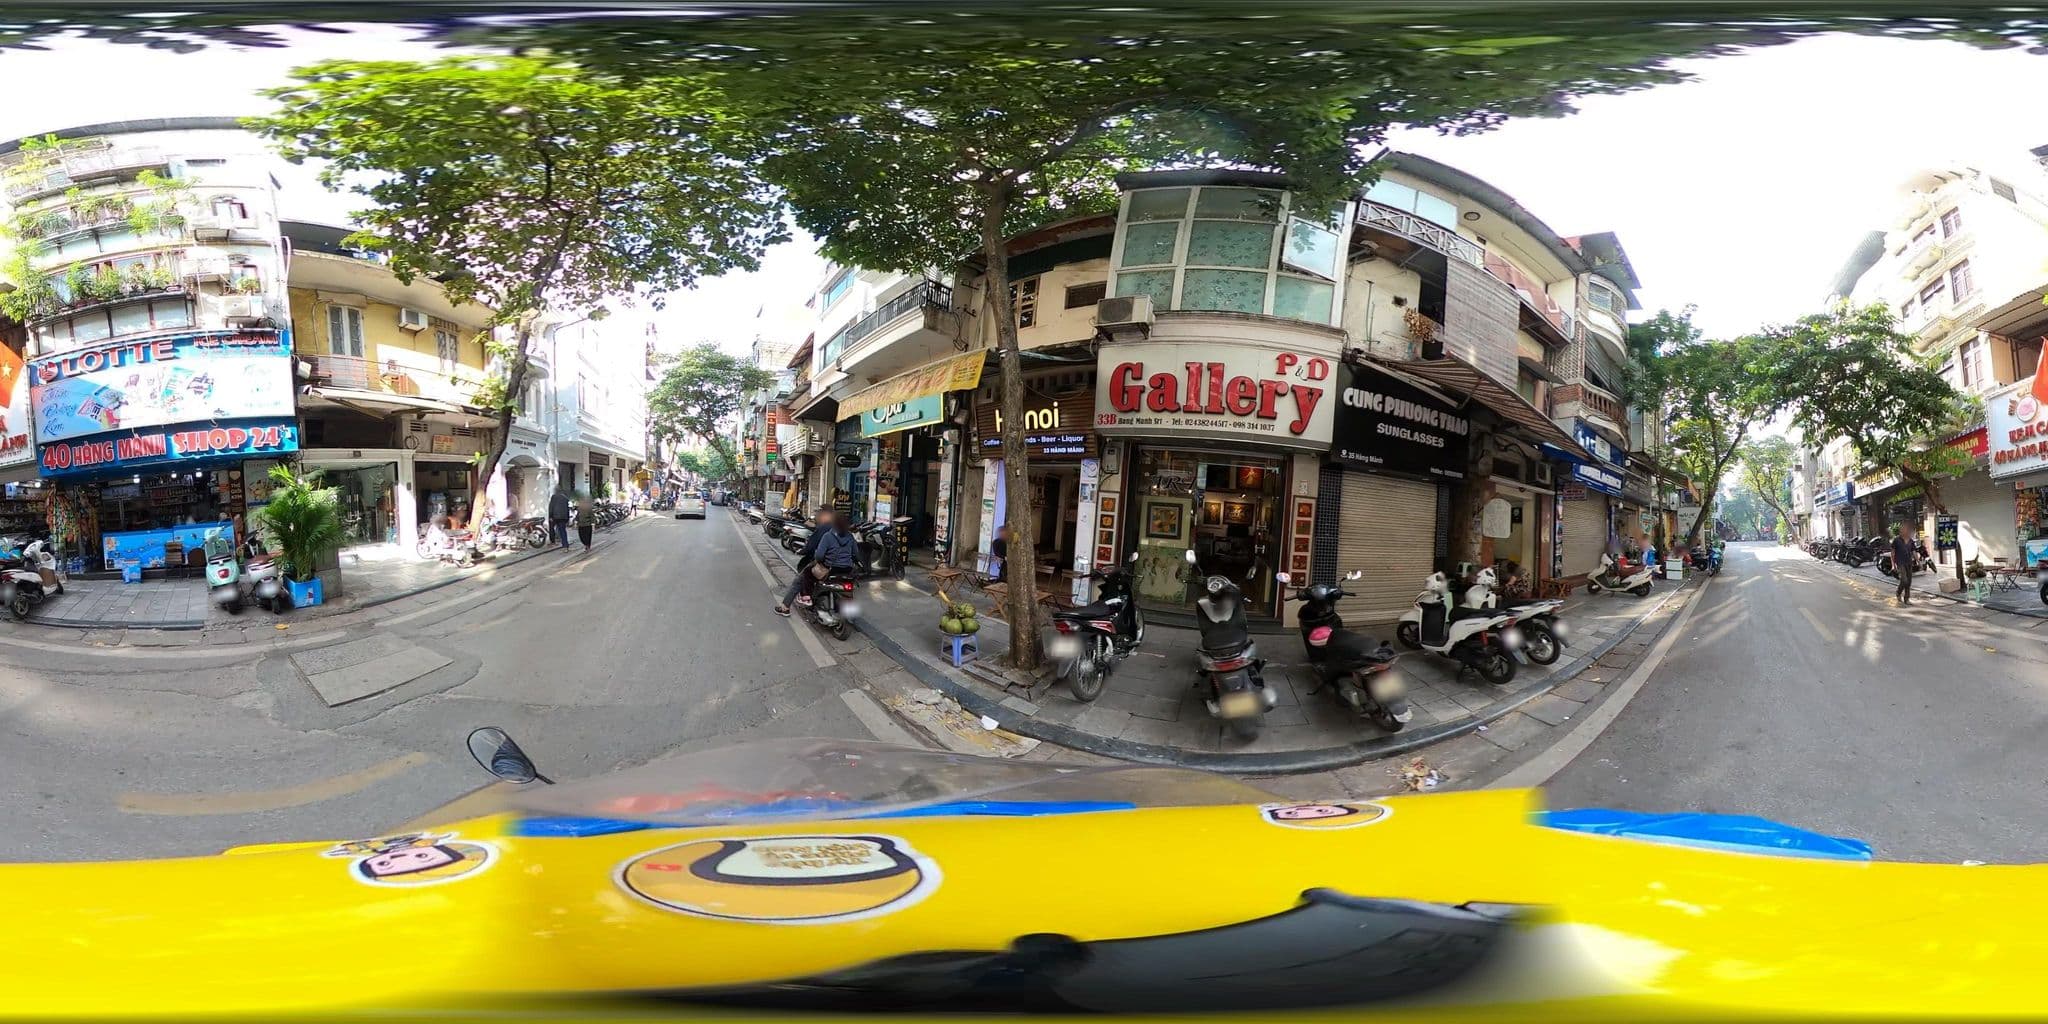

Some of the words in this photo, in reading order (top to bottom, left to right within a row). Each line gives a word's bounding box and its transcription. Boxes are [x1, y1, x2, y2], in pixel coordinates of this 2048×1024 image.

[61, 339, 174, 378] LOTTE
[1275, 352, 1298, 375] P
[1306, 357, 1329, 381] D
[1109, 361, 1324, 435] Gallery
[1343, 387, 1383, 412] CUNG
[994, 401, 1060, 433] Hnoi
[1097, 413, 1117, 425] 33B
[173, 427, 248, 454] SHOP
[1041, 435, 1057, 443] Beer
[1061, 434, 1084, 444] Liquor
[1376, 422, 1445, 448] SUNGLASSES
[43, 443, 71, 469] 40
[72, 440, 114, 466] HÀNG
[116, 432, 166, 460] MÀNH
